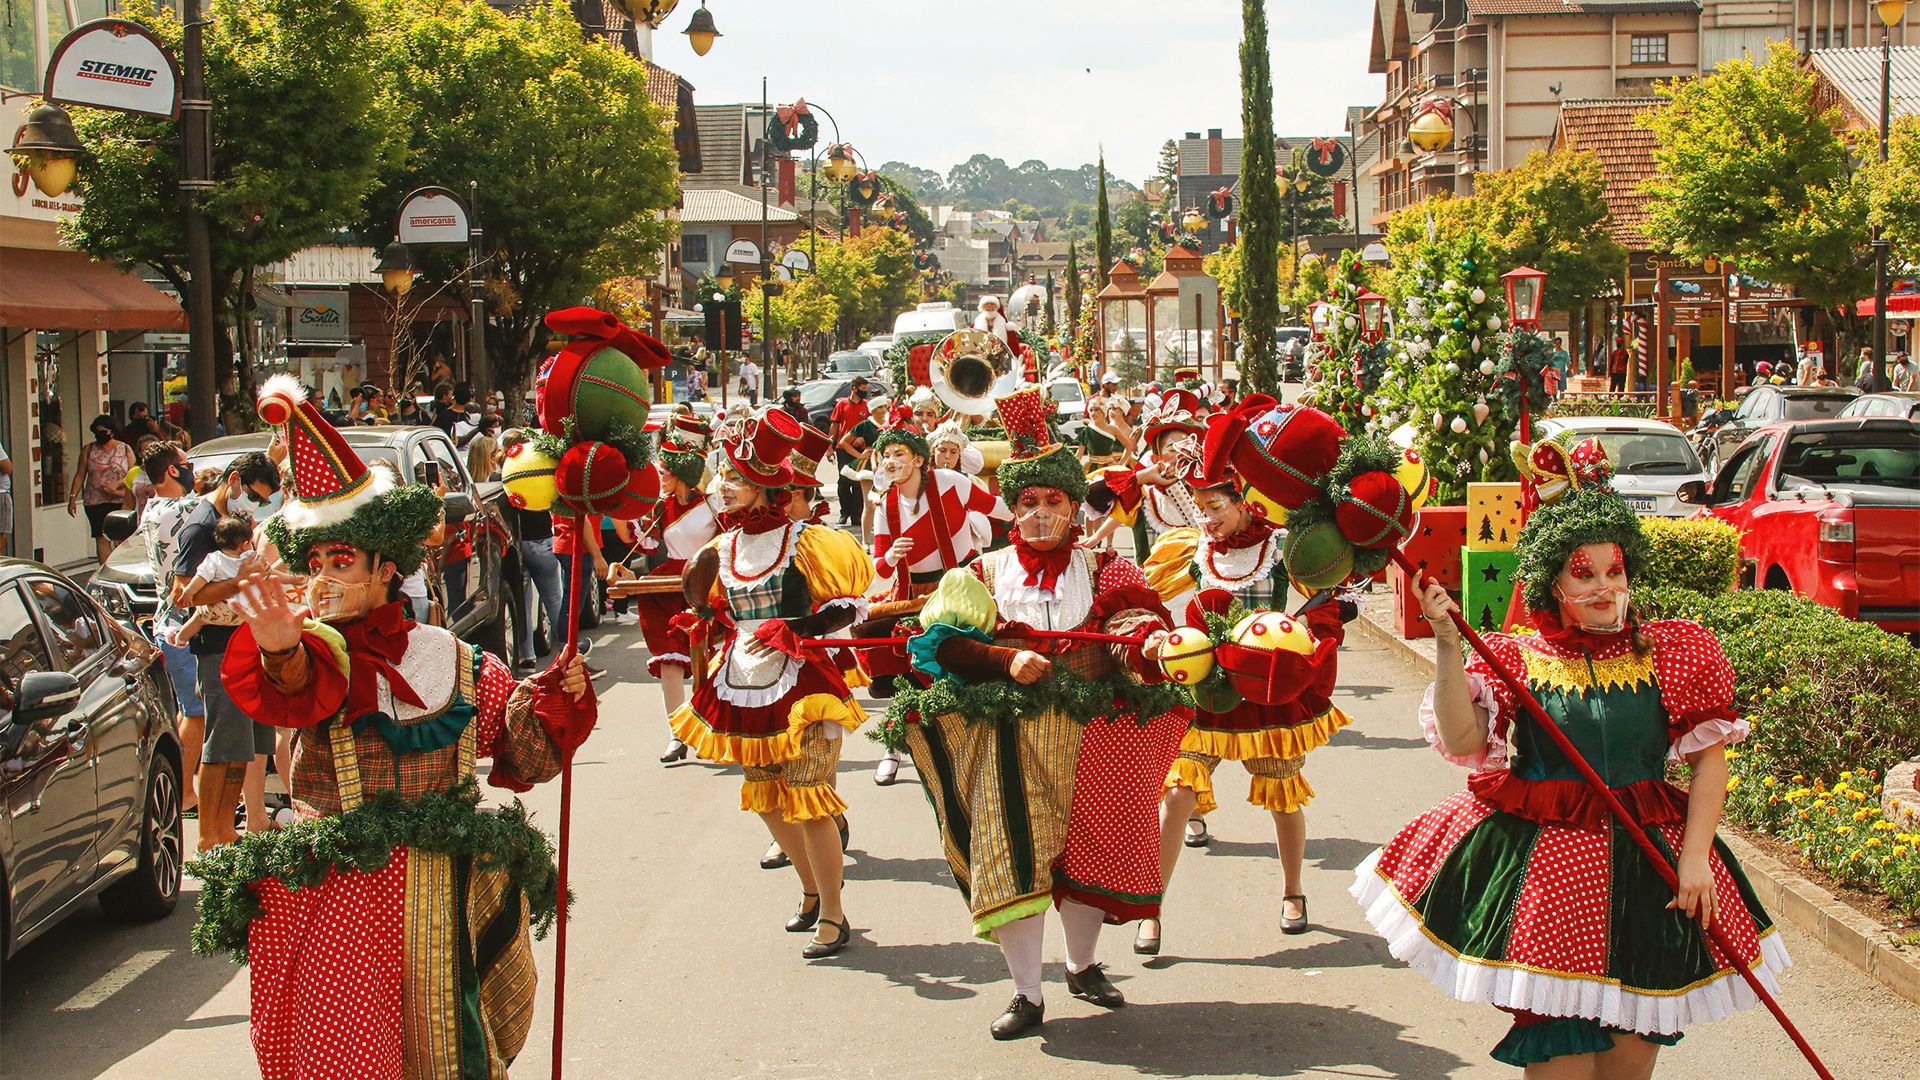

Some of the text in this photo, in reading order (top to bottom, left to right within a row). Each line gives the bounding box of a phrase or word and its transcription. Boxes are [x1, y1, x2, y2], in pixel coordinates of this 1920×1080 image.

[80, 59, 157, 81] STEMAC
[410, 217, 456, 225] americanas
[1645, 255, 1685, 271] Santa
[672, 370, 678, 378] P
